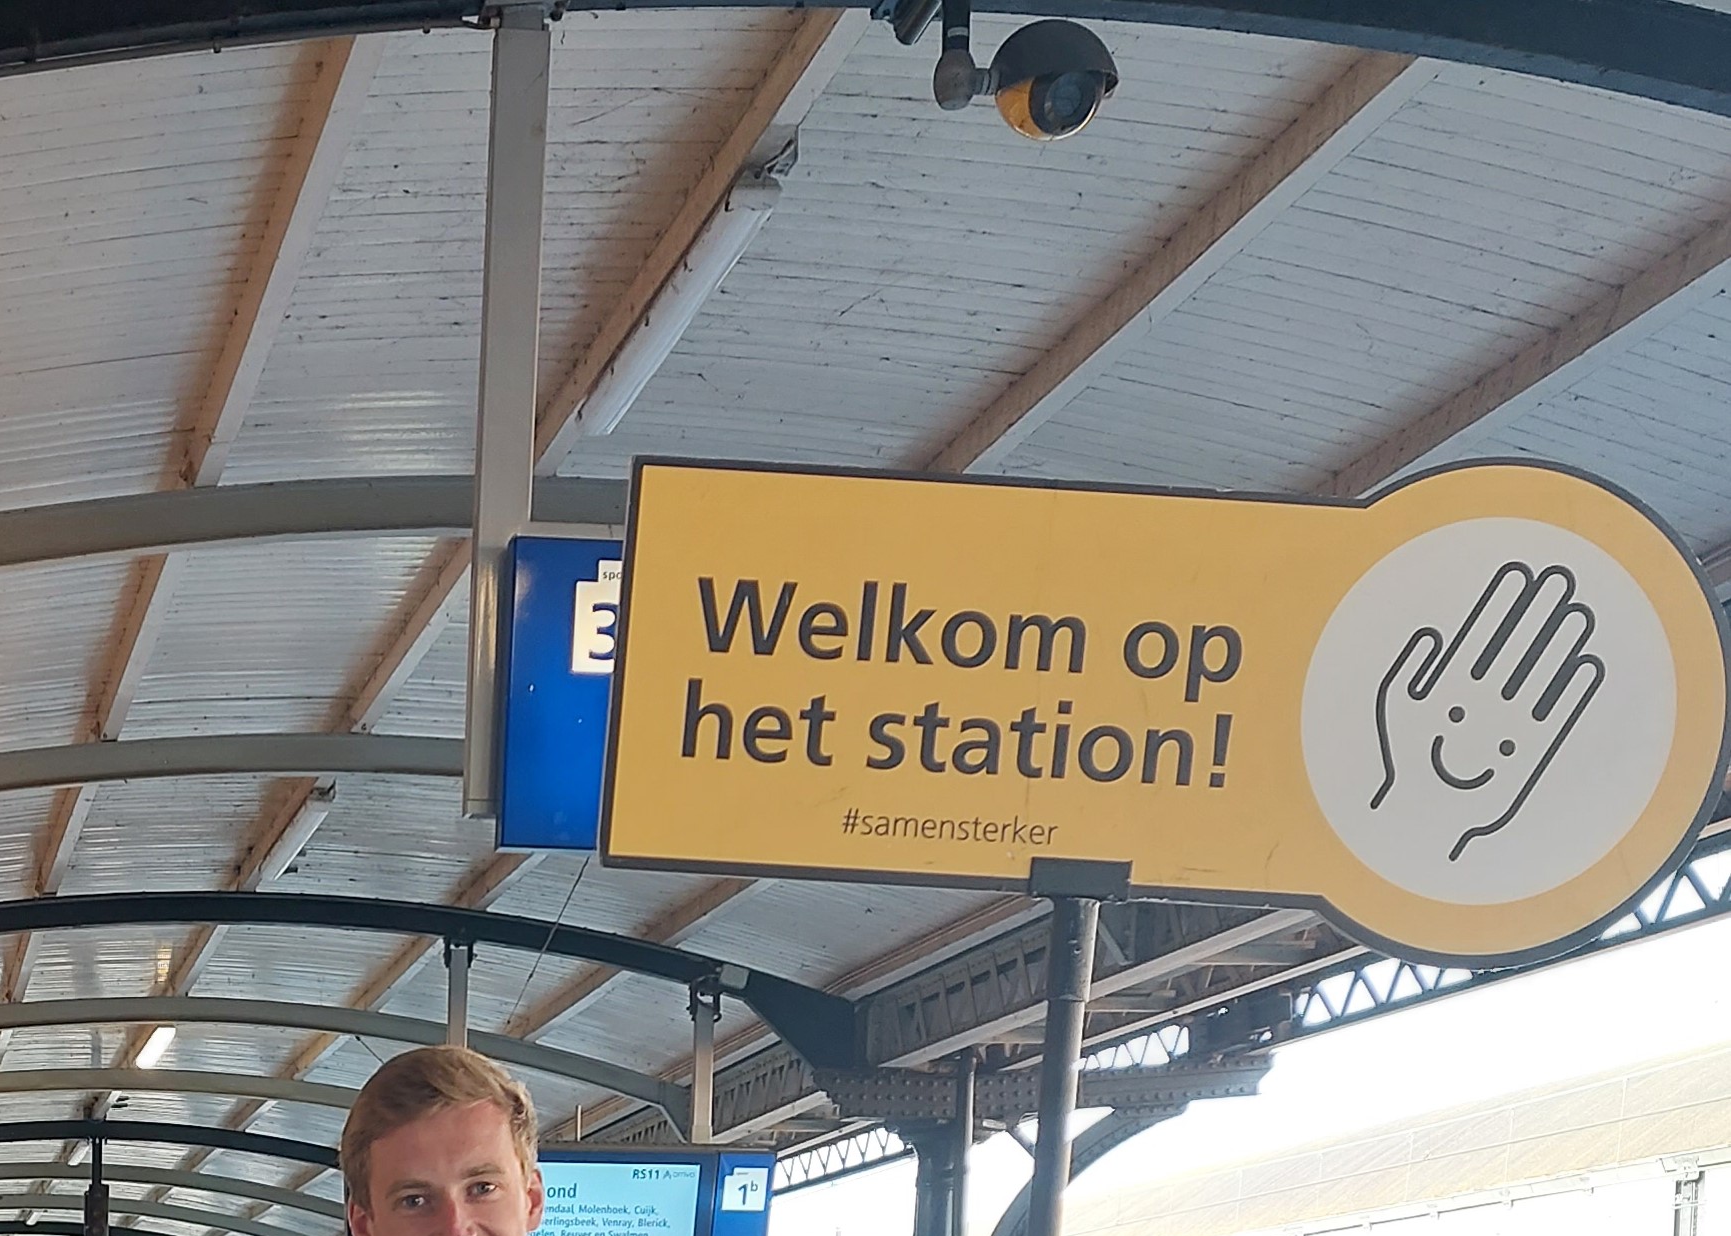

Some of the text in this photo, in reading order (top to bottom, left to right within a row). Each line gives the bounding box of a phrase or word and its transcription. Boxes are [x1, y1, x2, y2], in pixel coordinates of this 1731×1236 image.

[698, 576, 1243, 702] Welkom op
[681, 677, 1234, 788] het station!
[841, 808, 1059, 845] #samensterker
[632, 1168, 660, 1180] RS11
